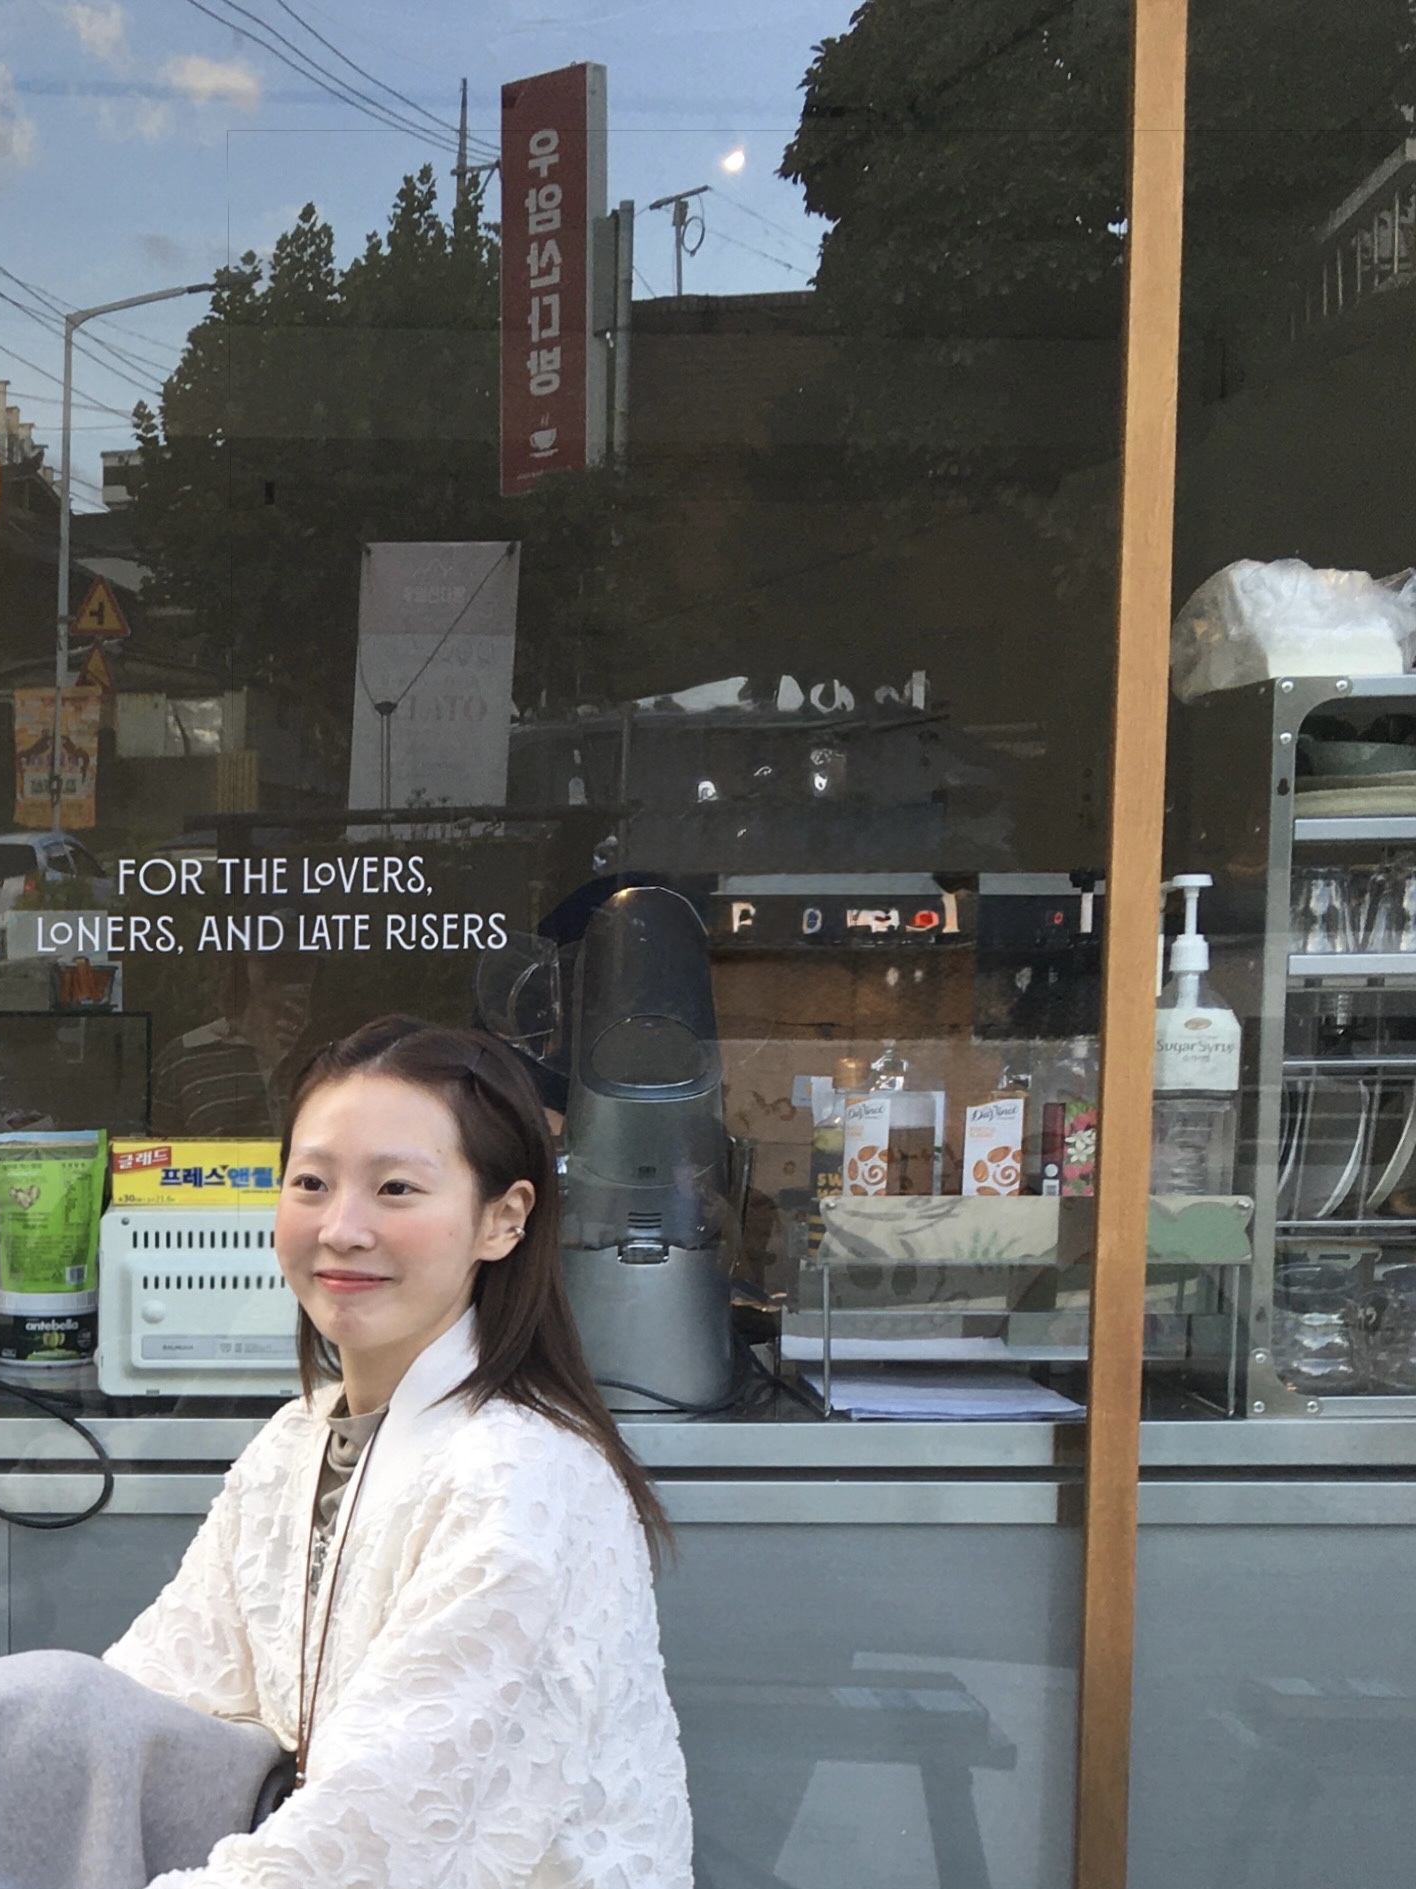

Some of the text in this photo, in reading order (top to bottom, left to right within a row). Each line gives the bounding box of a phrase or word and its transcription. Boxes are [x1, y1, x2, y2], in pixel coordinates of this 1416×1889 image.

[118, 857, 206, 896] FOR
[216, 857, 288, 895] THE
[196, 915, 285, 952] AND
[298, 914, 371, 951] LATE
[385, 913, 508, 950] RISERS
[118, 1147, 169, 1170] 글래드
[25, 1318, 79, 1331] antebella
